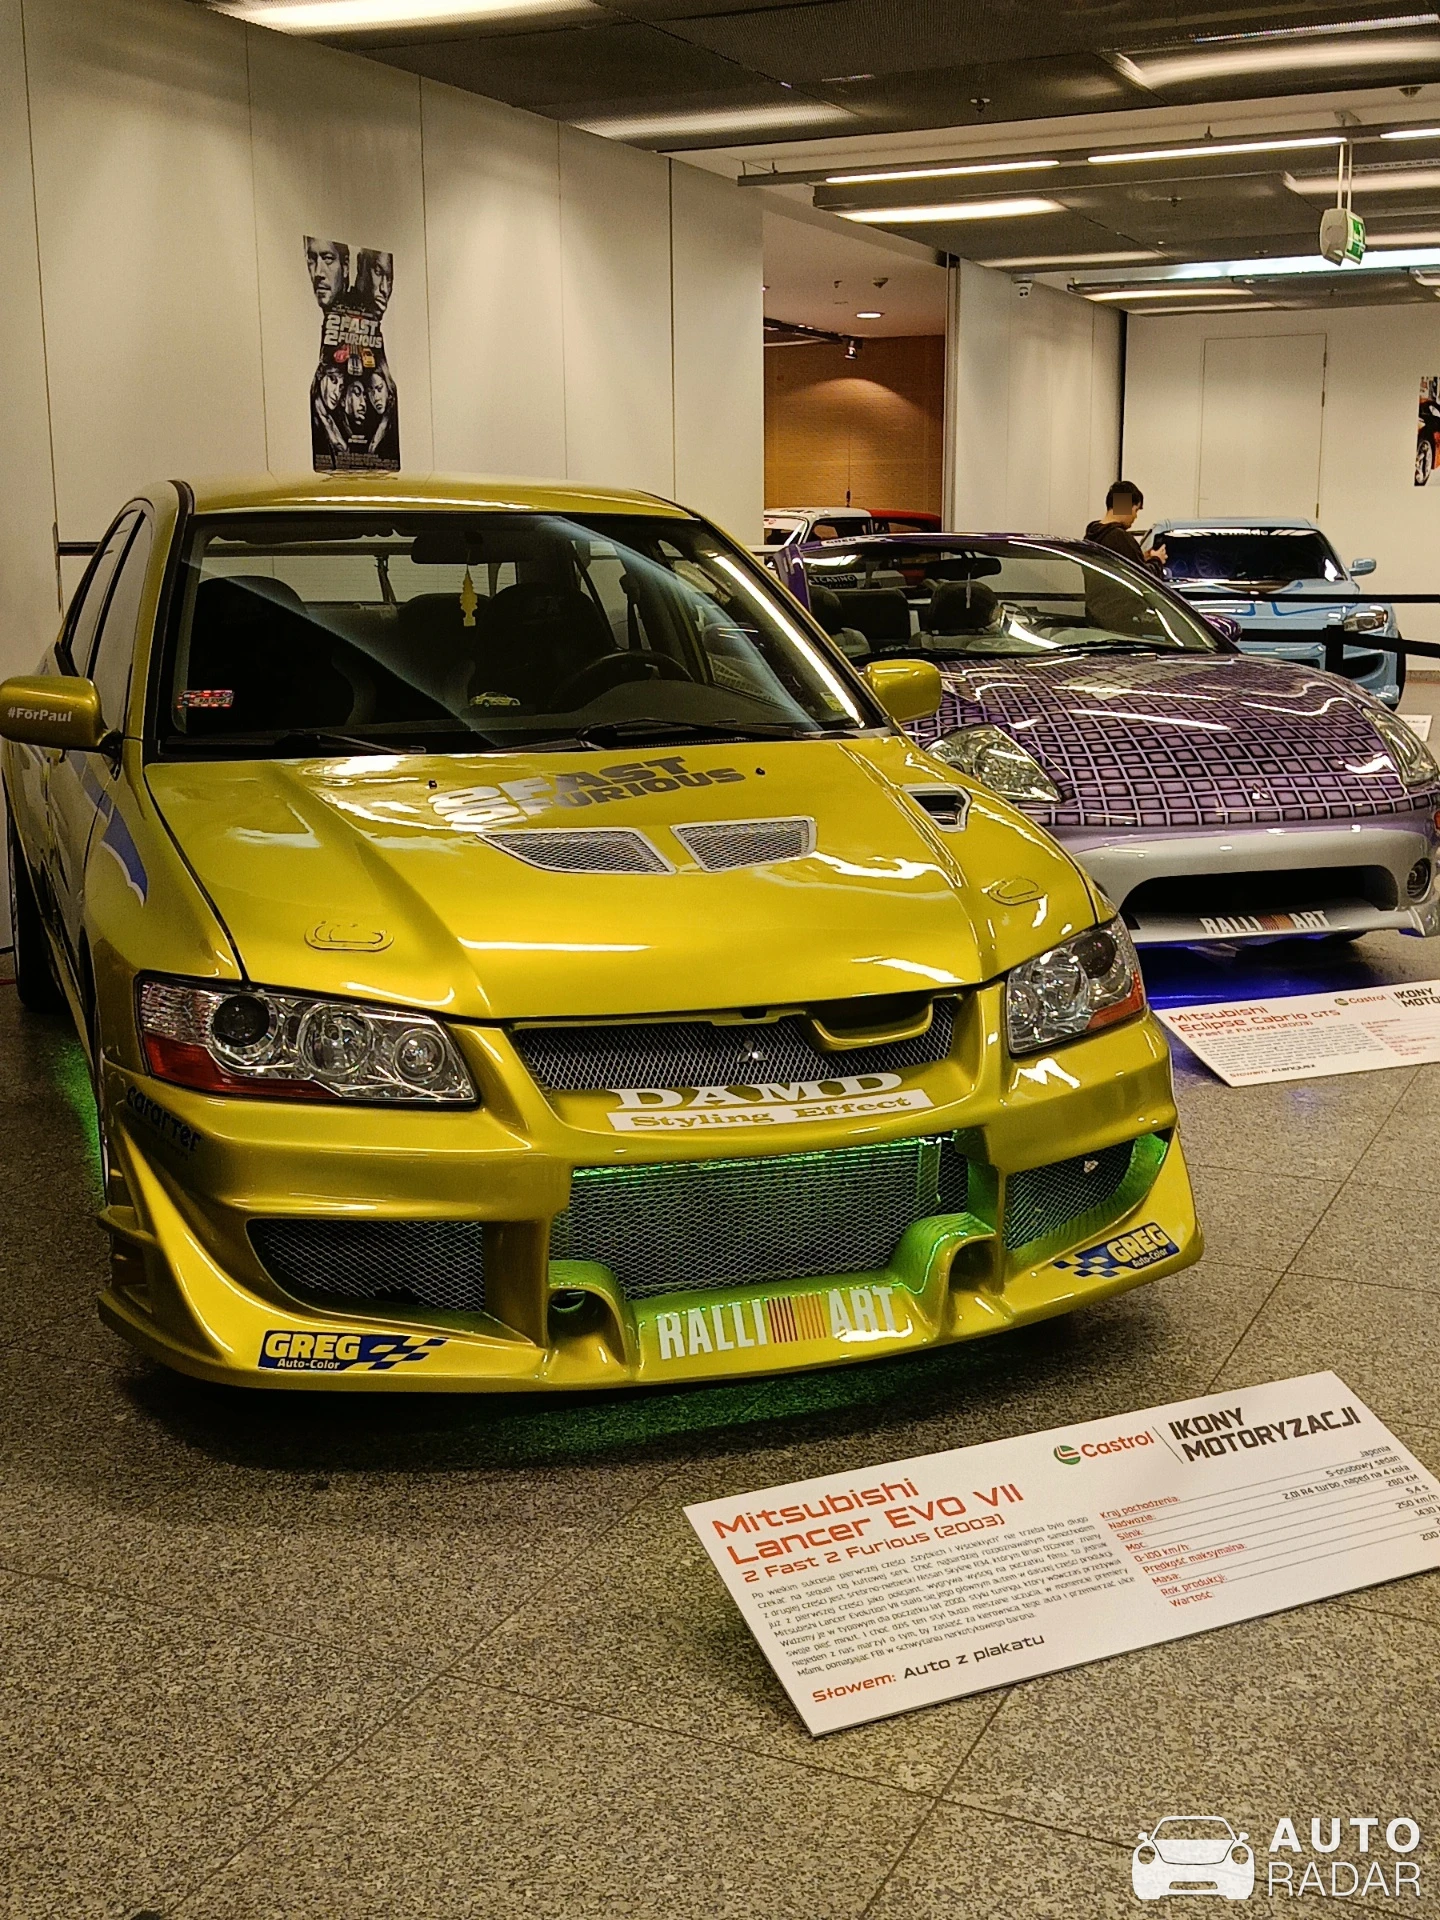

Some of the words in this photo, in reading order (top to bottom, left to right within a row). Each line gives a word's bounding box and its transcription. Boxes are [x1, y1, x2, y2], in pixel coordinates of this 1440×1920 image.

[326, 314, 340, 330] 2
[340, 315, 378, 335] FAST
[324, 329, 338, 346] 2
[338, 332, 382, 348] FURIOUS
[7, 707, 72, 723] #ForPaul
[498, 756, 691, 800] FAST
[518, 767, 746, 816] FURIOUS
[1349, 995, 1387, 1004] Castrol
[1393, 987, 1434, 999] IKONY
[1401, 996, 1440, 1008] MOTO
[1168, 1006, 1269, 1023] Mitsubishi
[1178, 1020, 1247, 1032] Eclipse
[1251, 1013, 1308, 1024] Cabrio
[1311, 1009, 1341, 1018] GTS
[606, 1072, 903, 1110] DAMD
[630, 1110, 770, 1128] Styling
[793, 1096, 913, 1119] Effect
[1107, 1225, 1170, 1263] GREG
[1132, 1247, 1168, 1267] Auto-Color
[265, 1333, 361, 1360] GREG
[277, 1358, 340, 1369] Auto-Color
[1168, 1407, 1244, 1440] IKONY
[1181, 1406, 1361, 1462] MOTORYZACJI
[1081, 1430, 1154, 1458] Castrol
[1360, 1445, 1391, 1458] Japonia
[1326, 1463, 1374, 1477] 5-osobowy
[1374, 1455, 1401, 1466] sedan
[1301, 1487, 1315, 1496] R4
[1315, 1480, 1344, 1492] turbo,
[1344, 1474, 1371, 1486] napęd
[1371, 1471, 1383, 1479] na
[1386, 1478, 1404, 1487] 280
[1404, 1474, 1419, 1482] KM
[712, 1478, 919, 1538] Mitsubishi
[1099, 1509, 1121, 1519] Kraj
[1121, 1496, 1181, 1515] pochodzenia:
[1395, 1500, 1415, 1509] 250
[1413, 1494, 1439, 1504] km/h
[1414, 1507, 1436, 1516] 1430
[726, 1518, 871, 1565] Lancer
[884, 1496, 966, 1529] EVO
[972, 1483, 1024, 1507] VII
[1107, 1514, 1157, 1530] Nadwozie:
[1116, 1529, 1144, 1541] Silnik:
[742, 1570, 760, 1583] 2
[764, 1557, 820, 1578] Fast
[823, 1551, 842, 1564] 2
[845, 1532, 930, 1559] Furious
[933, 1513, 1005, 1539] (2003)
[1133, 1550, 1162, 1563] 0-100
[1142, 1557, 1188, 1574] Prędkość
[1188, 1543, 1247, 1562] maksymalna:
[1151, 1574, 1181, 1585] Masa:
[1160, 1586, 1181, 1596] Rok
[812, 1674, 896, 1703] Słowem:
[904, 1659, 951, 1679] Auto
[955, 1654, 969, 1665] z
[973, 1635, 1045, 1663] plakatu
